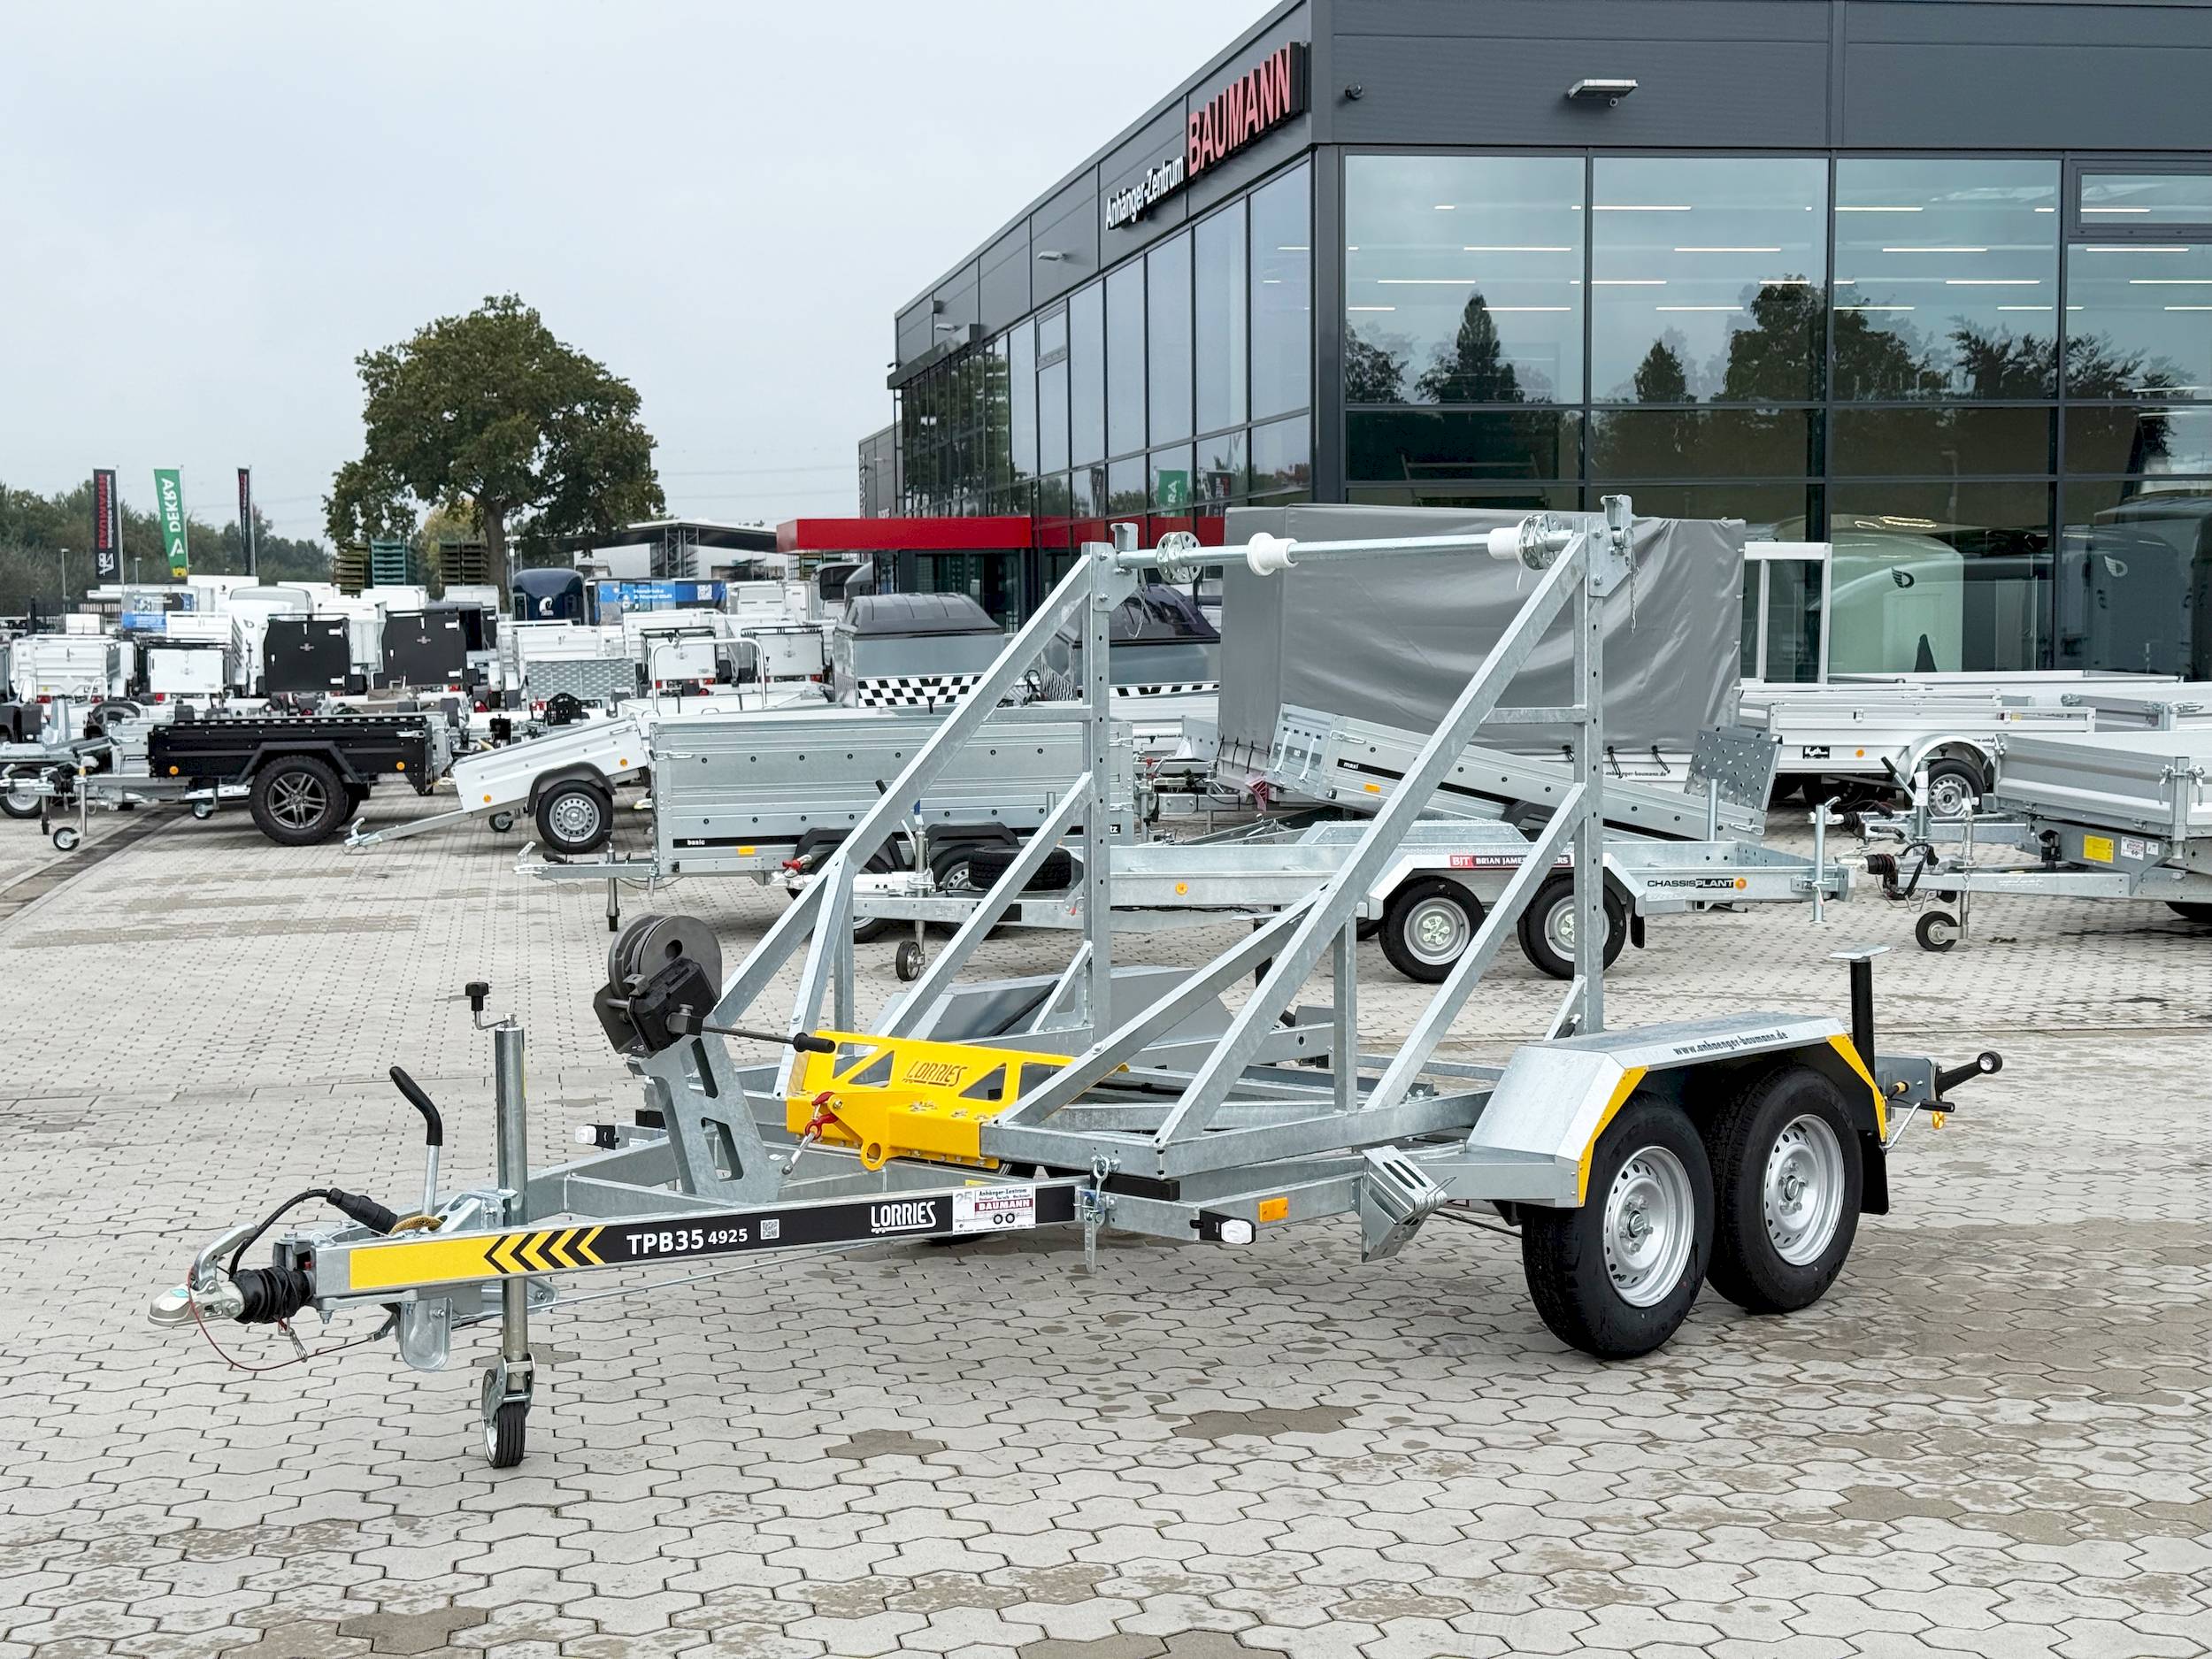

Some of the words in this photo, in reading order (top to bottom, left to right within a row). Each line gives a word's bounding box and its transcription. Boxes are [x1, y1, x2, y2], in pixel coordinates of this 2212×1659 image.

[1105, 156, 1185, 230] Anhänger-Zentrum
[1188, 42, 1292, 177] BAUMANN
[1452, 856, 1470, 866] BJT
[1476, 856, 1501, 865] BRIAN
[1647, 879, 1733, 888] CHASSISPLANT
[1672, 1029, 1789, 1056] www.anhaenger-baumann.de
[906, 1061, 968, 1087] LORRIES
[956, 1191, 972, 1204] 25
[979, 1200, 1030, 1211] BAUMANN
[871, 1201, 937, 1230] LORRIES
[626, 1229, 704, 1255] TPB35
[708, 1228, 749, 1245] 4925
